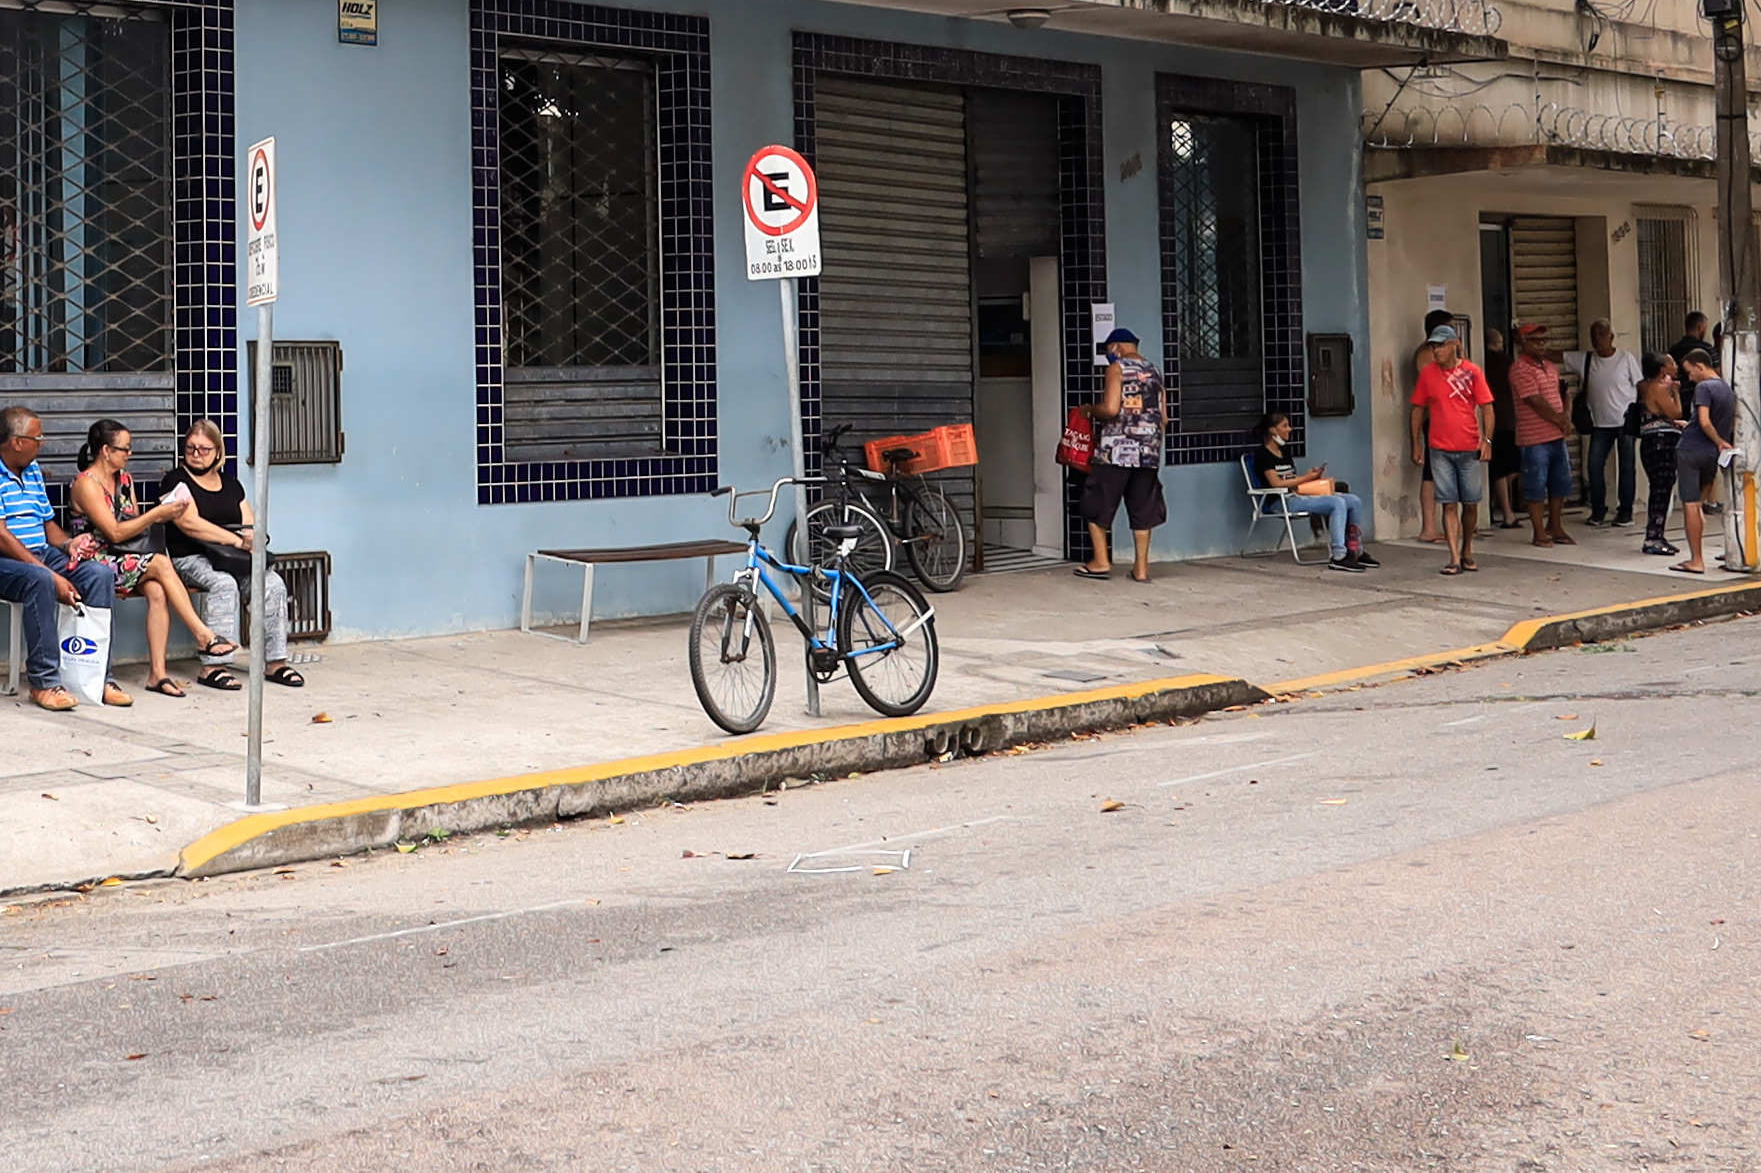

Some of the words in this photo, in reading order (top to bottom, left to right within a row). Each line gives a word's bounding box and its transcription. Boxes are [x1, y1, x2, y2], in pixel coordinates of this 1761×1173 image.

[341, 1, 374, 16] HOLZ
[255, 166, 264, 214] E
[763, 171, 792, 212] E
